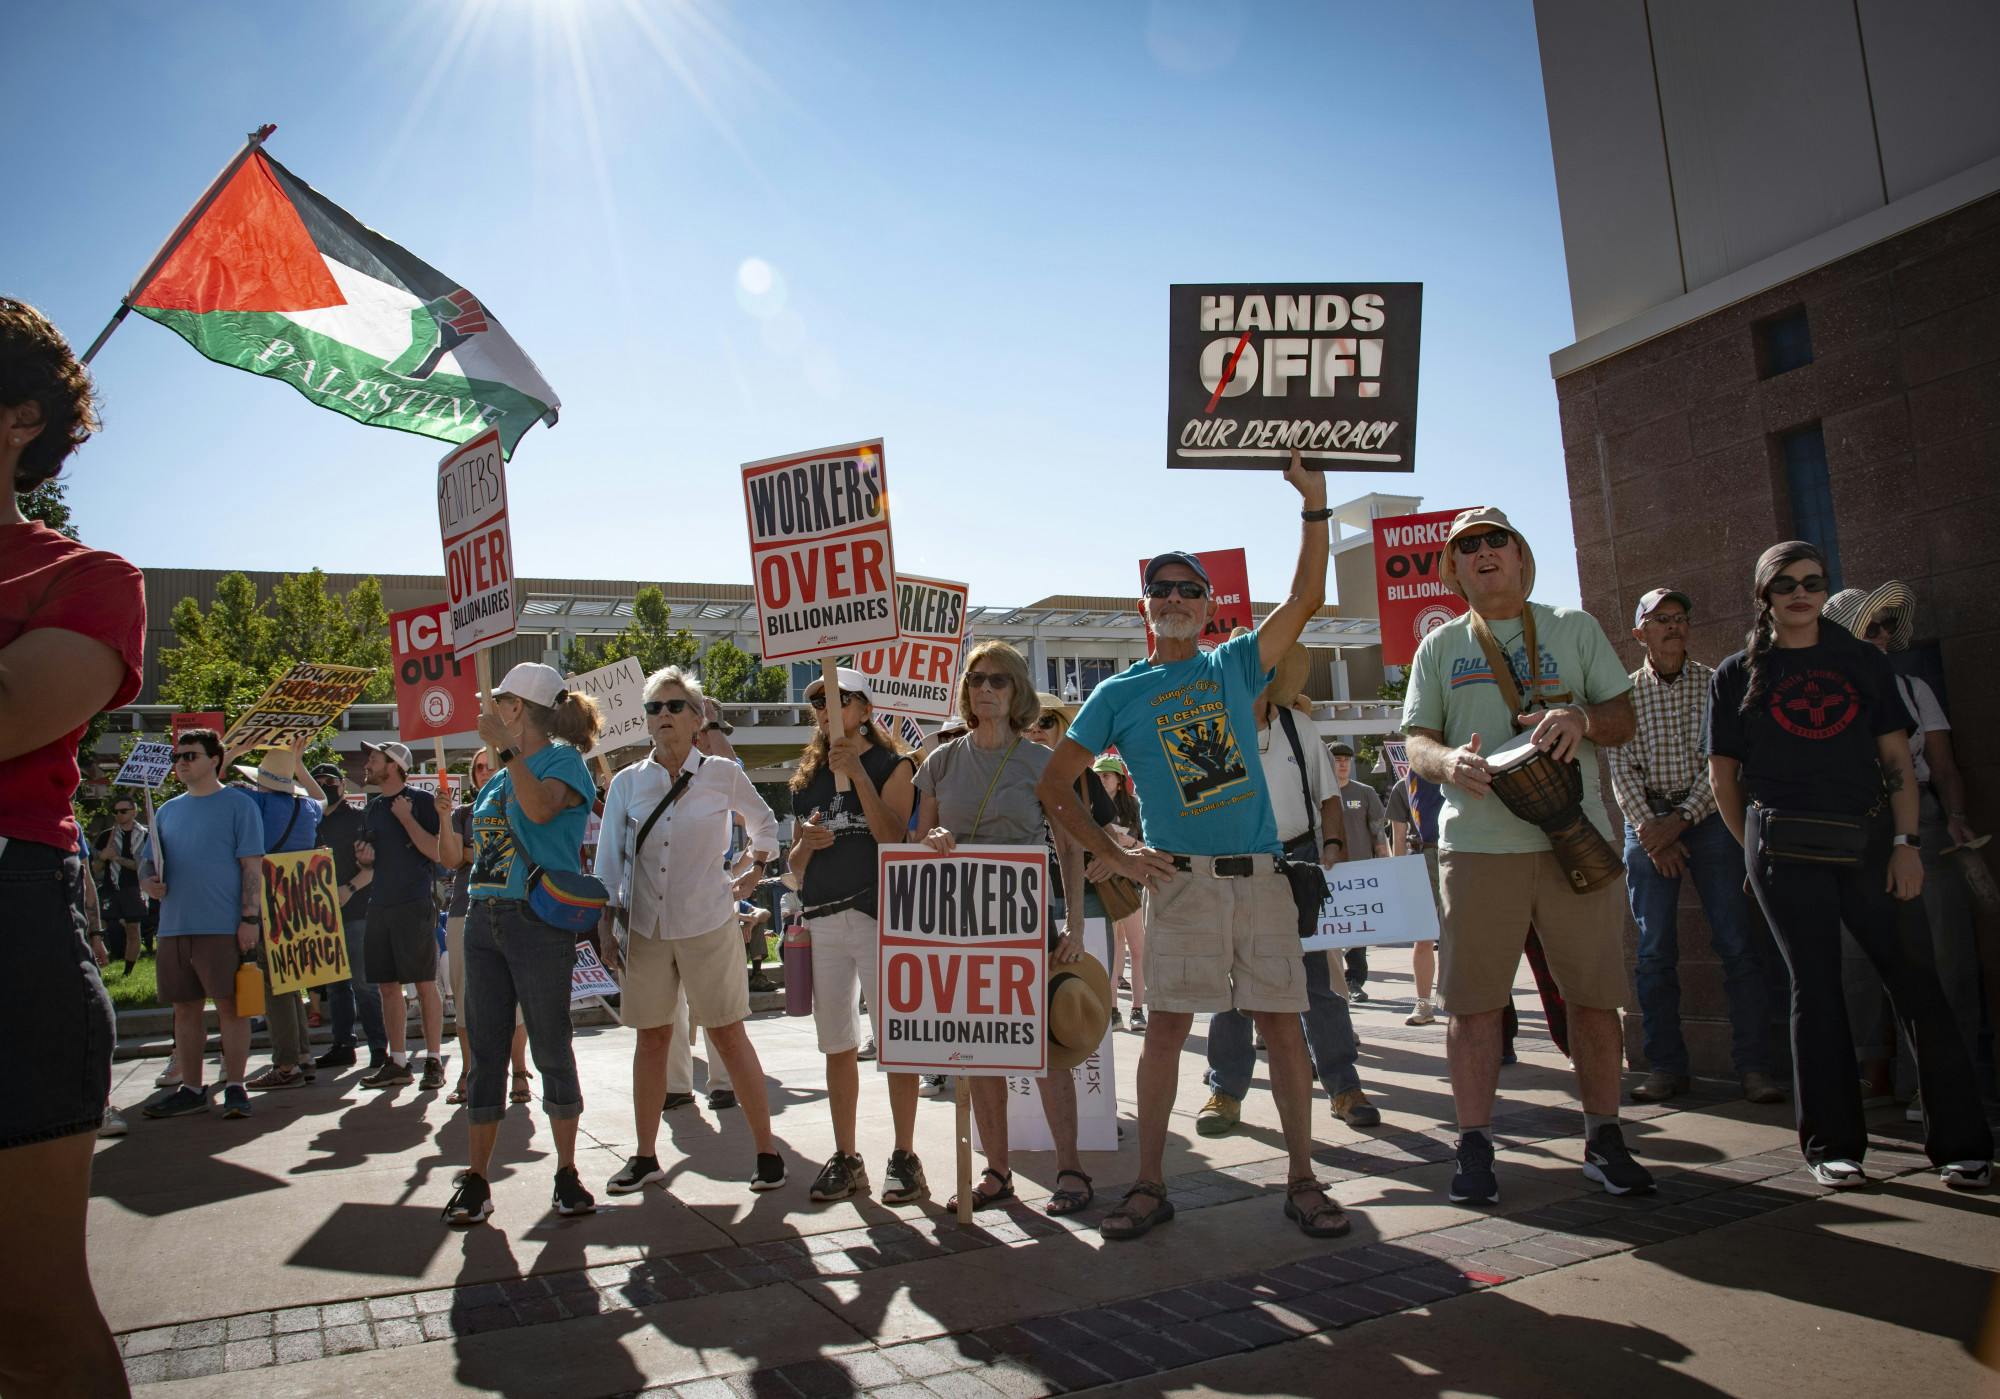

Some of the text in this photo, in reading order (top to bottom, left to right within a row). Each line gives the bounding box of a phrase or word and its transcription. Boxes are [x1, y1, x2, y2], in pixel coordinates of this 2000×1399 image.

[1199, 294, 1385, 332] HANDS
[1199, 336, 1384, 398] OFF!
[255, 338, 507, 430] PALESTINE
[1180, 418, 1399, 450] OUR DEMOCRACY
[440, 453, 499, 533] RENTERS
[750, 461, 881, 537] WORKERS
[1384, 523, 1454, 547] WORKE
[448, 529, 508, 605] OVER
[760, 539, 887, 609] OVER
[1386, 551, 1442, 579] OV
[1215, 594, 1241, 605] ARE
[1388, 582, 1453, 600] BILLIONA
[453, 588, 509, 631] BILLIONAIRES
[767, 598, 889, 636] BILLIONAIRES
[897, 584, 961, 634] RKERS
[402, 653, 461, 685] OUT
[861, 642, 953, 684] OVER
[608, 693, 623, 710] IS
[867, 678, 947, 701] ILLIONAIRES
[247, 712, 330, 727] EPSTEIN
[598, 715, 644, 739] LAVERY
[1173, 701, 1224, 722] CENTRO
[131, 754, 170, 765] WORKERS
[147, 766, 167, 777] THE
[262, 857, 337, 942] KINGS
[888, 862, 1038, 937] WORKERS
[1314, 920, 1376, 936] TRU
[888, 953, 1036, 1016] OVER
[889, 1018, 1035, 1045] BILLIONAIRES
